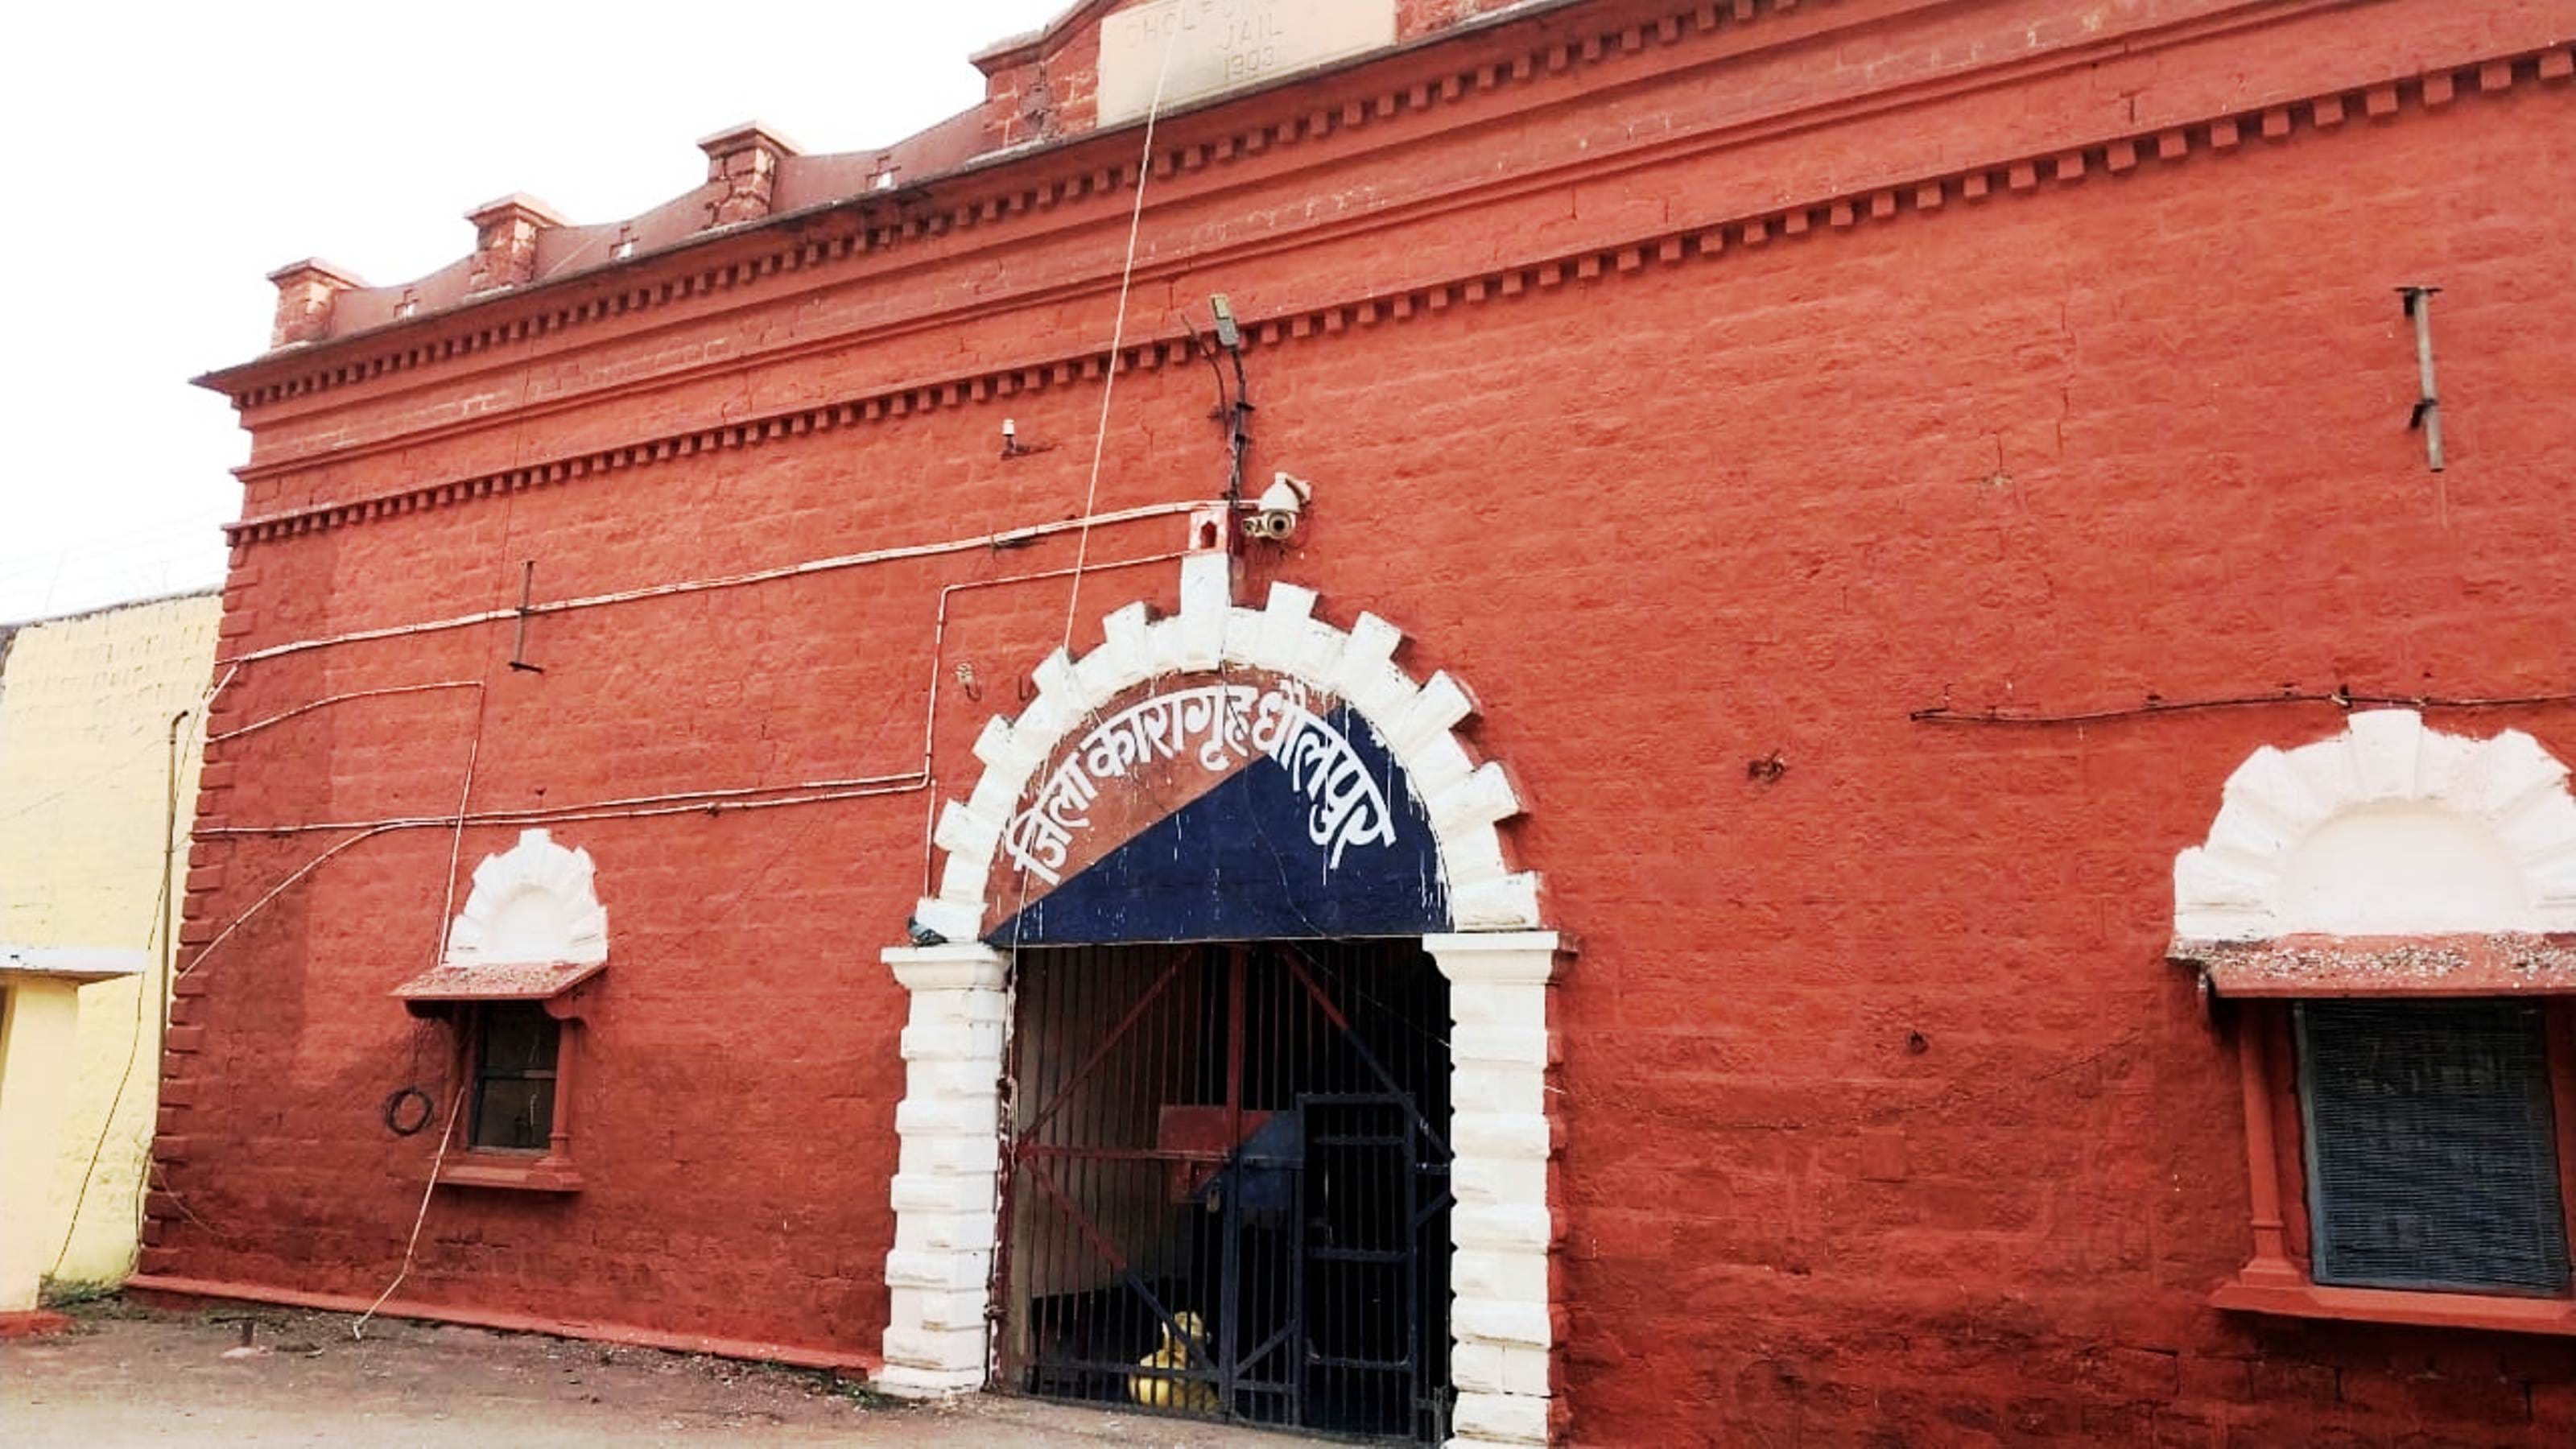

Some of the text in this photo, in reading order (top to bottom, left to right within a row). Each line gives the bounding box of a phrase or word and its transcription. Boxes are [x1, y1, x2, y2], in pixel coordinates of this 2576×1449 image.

[1216, 11, 1283, 51] JAIL
[1223, 47, 1275, 80] 1903
[1004, 679, 1397, 886] जिला कारागृह धौलपुर
